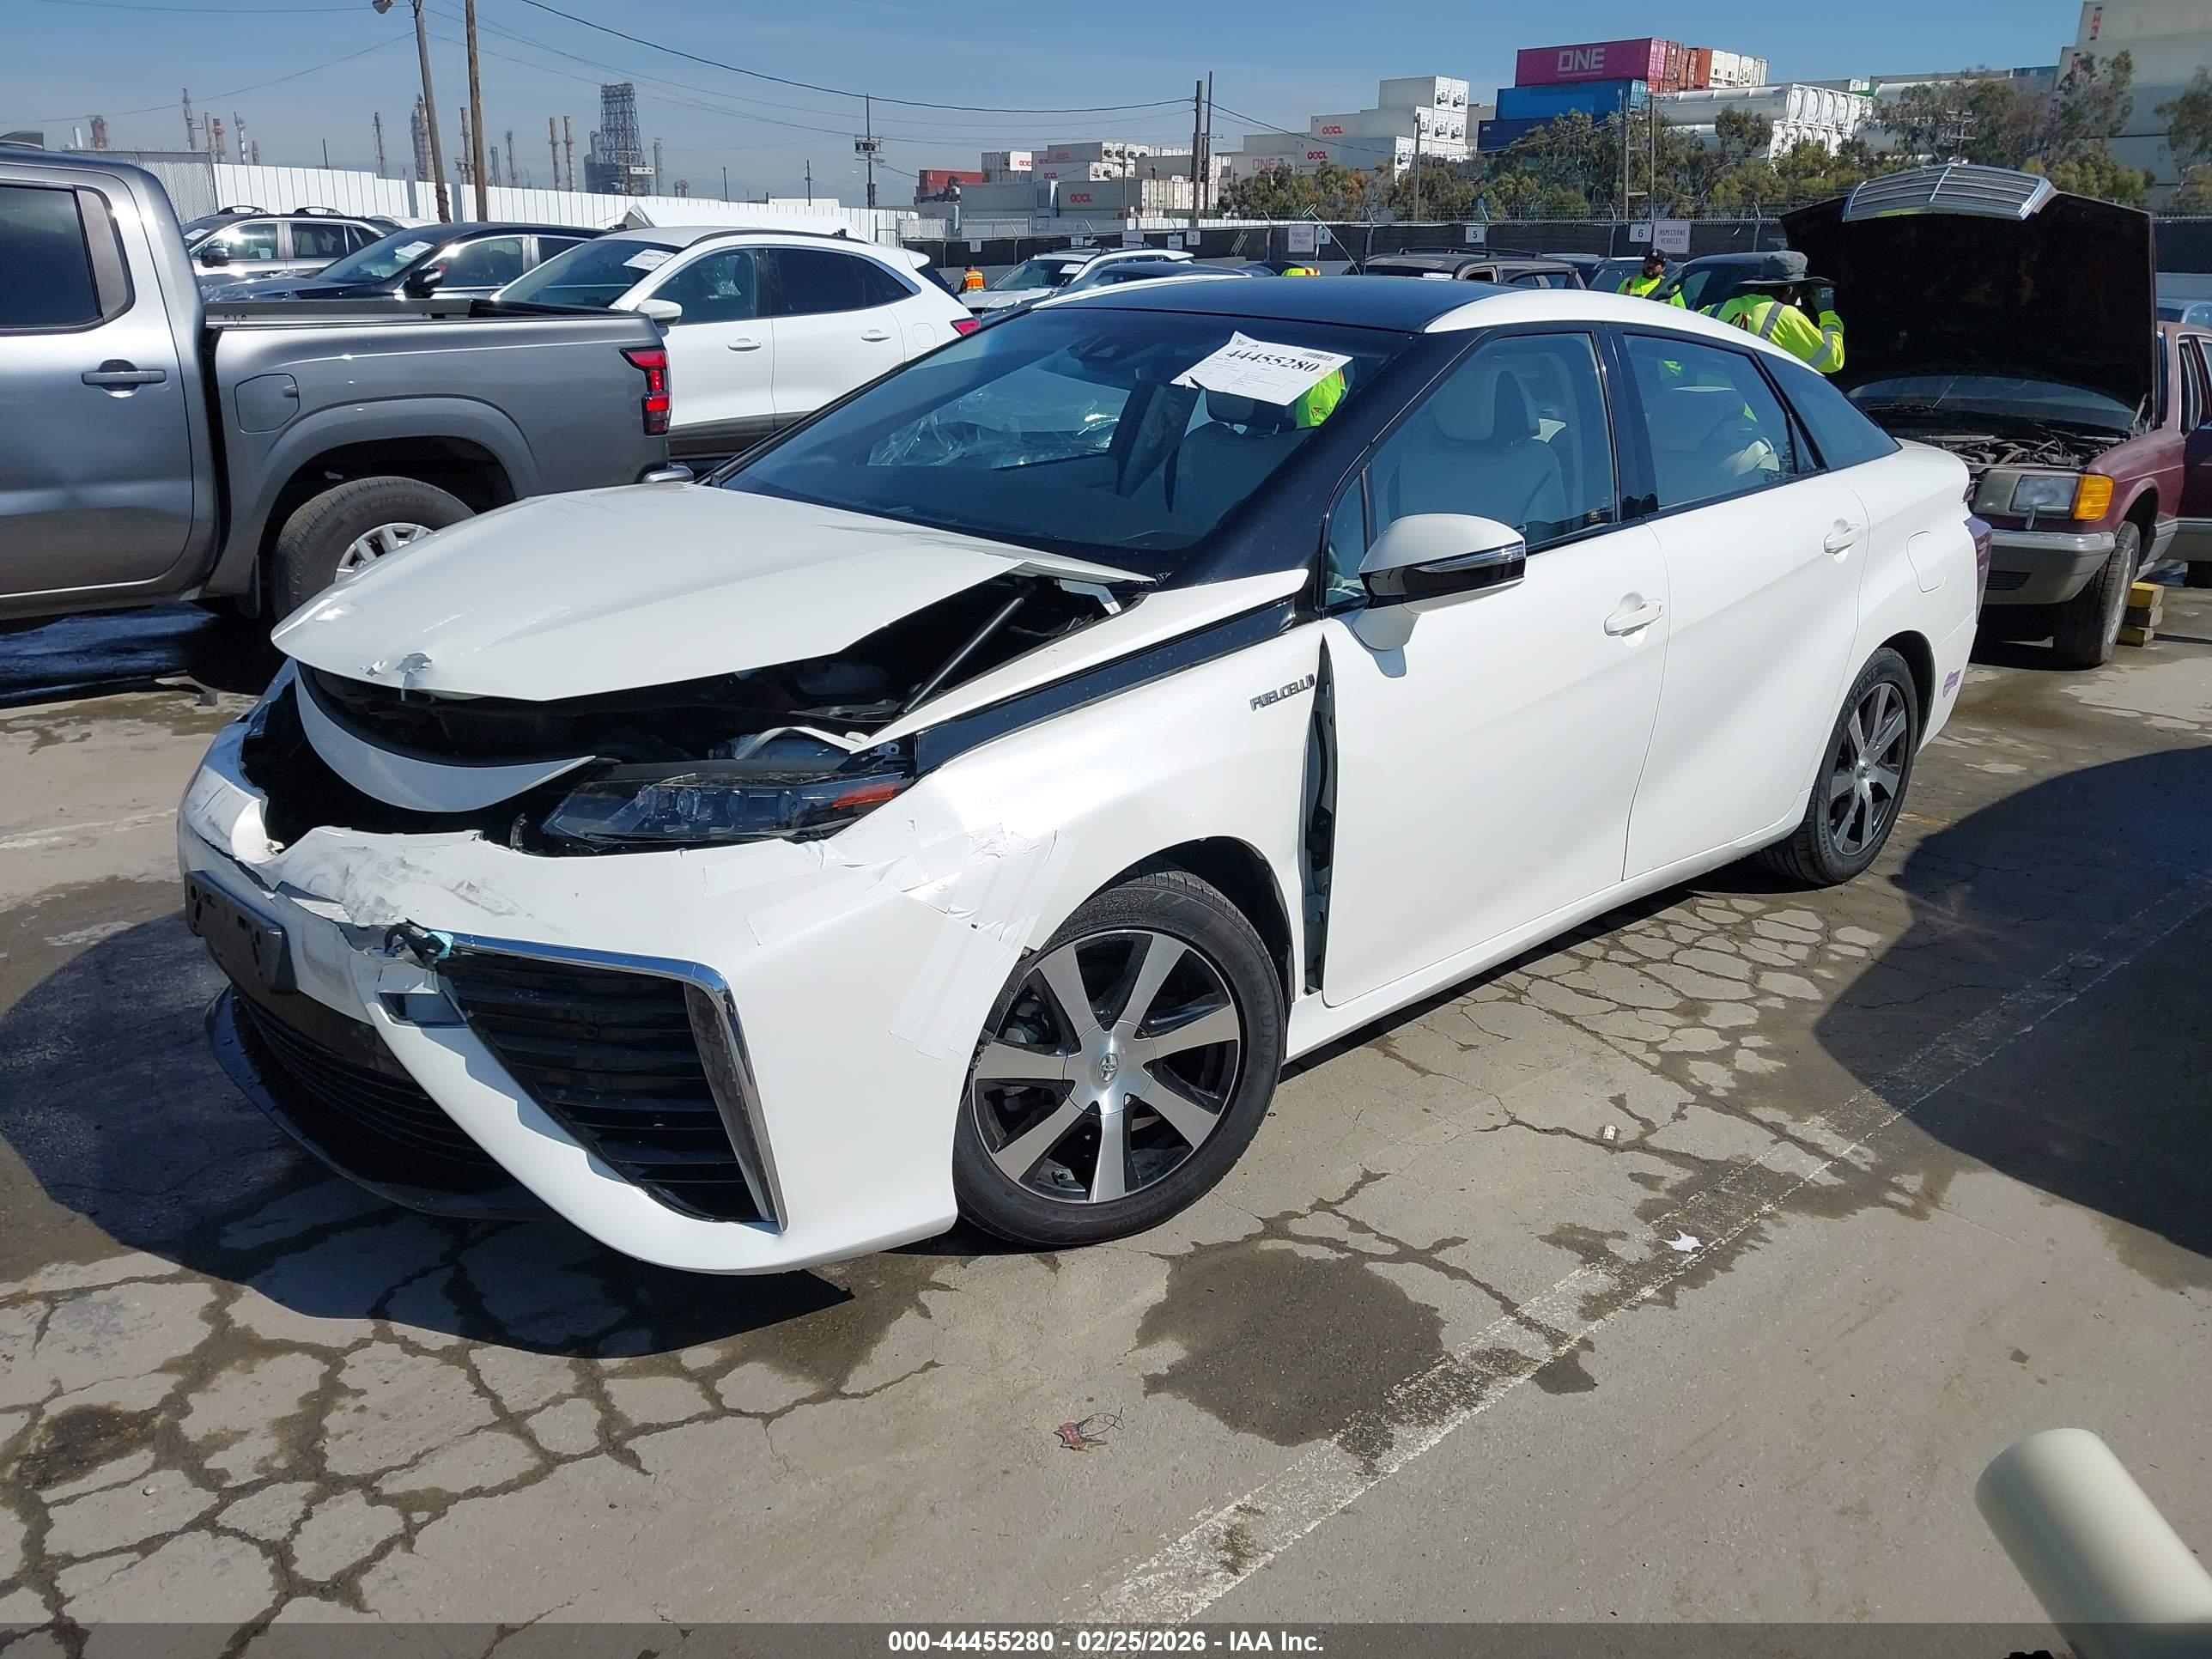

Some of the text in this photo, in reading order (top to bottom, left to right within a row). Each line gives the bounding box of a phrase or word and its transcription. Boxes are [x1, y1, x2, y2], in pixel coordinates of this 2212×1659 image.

[1558, 47, 1606, 72] ONE
[1322, 125, 1344, 135] OOCL
[1307, 150, 1328, 161] OOCL
[1252, 157, 1276, 172] ONE
[1070, 193, 1092, 203] OOCL
[1473, 230, 1478, 239] 5
[1638, 228, 1644, 238] 6
[1225, 349, 1321, 373] 44455280
